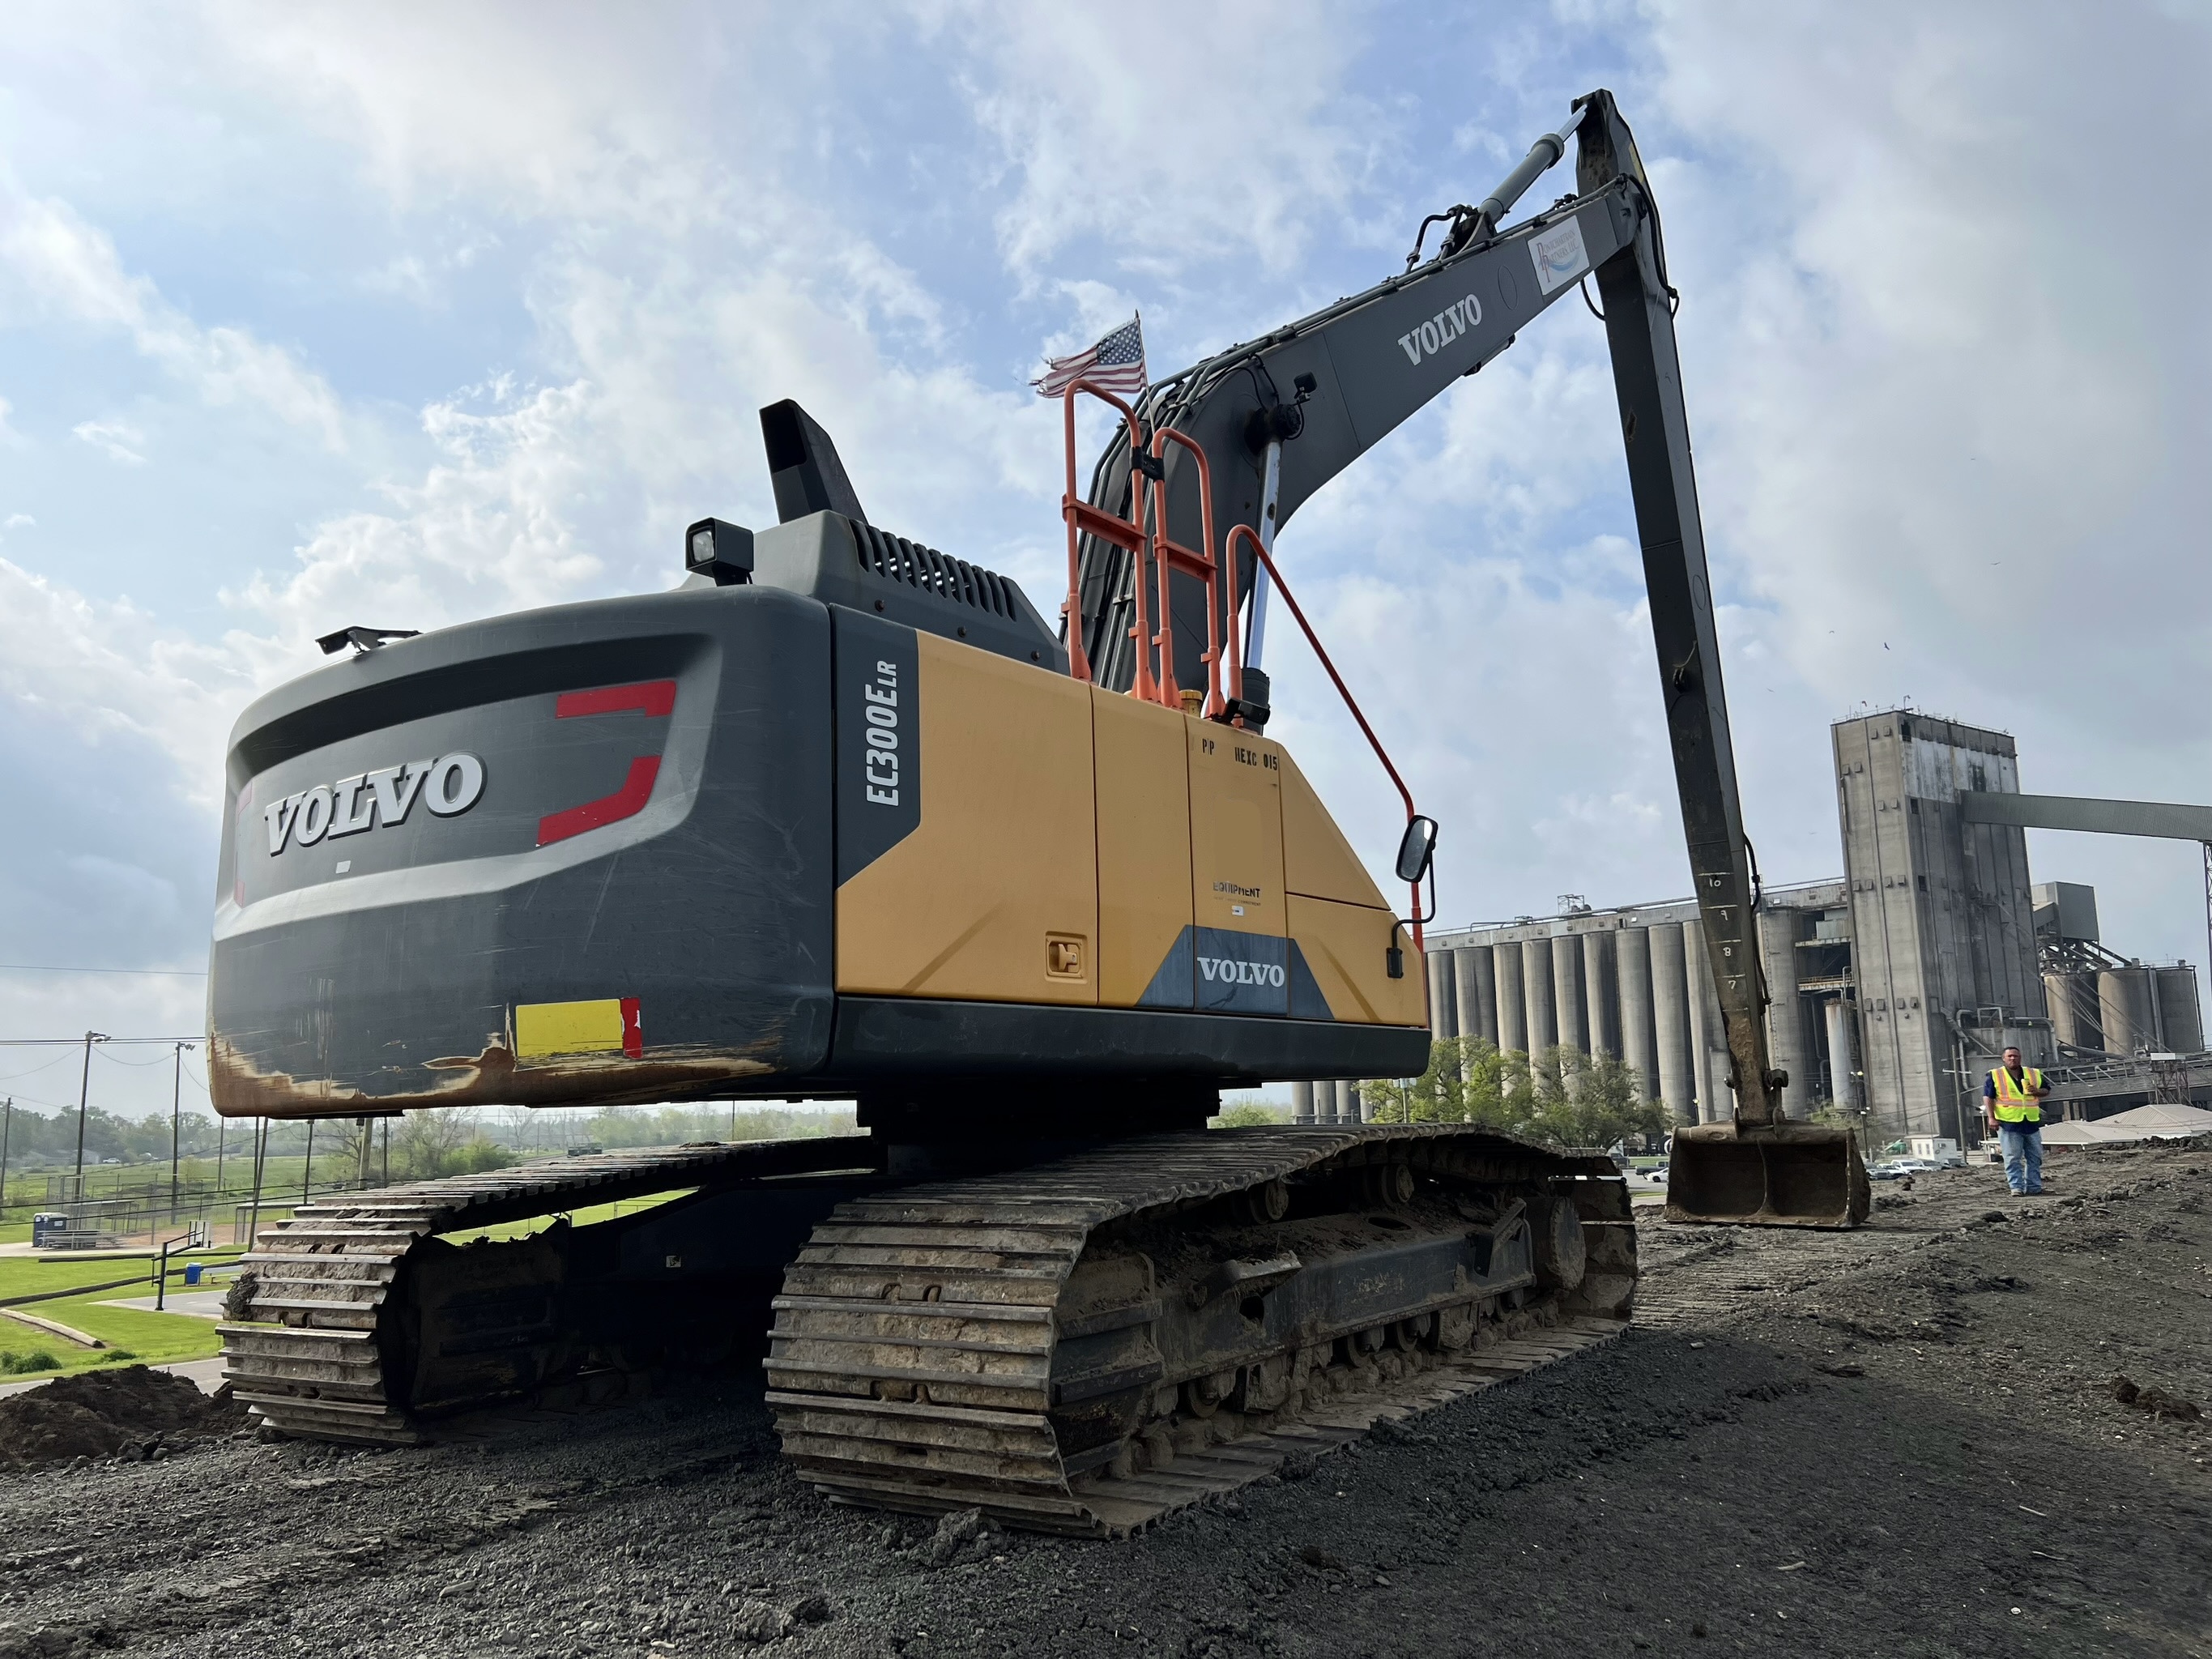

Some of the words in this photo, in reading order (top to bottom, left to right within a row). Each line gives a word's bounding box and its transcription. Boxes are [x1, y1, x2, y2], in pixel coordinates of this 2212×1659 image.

[1397, 294, 1482, 366] VOLVO
[1264, 753, 1277, 771] 015
[265, 751, 488, 857] VOLVO
[1709, 877, 1721, 888] 10
[1723, 946, 1732, 957] 8
[1197, 957, 1285, 987] VOLVO
[1728, 979, 1737, 990] 7
